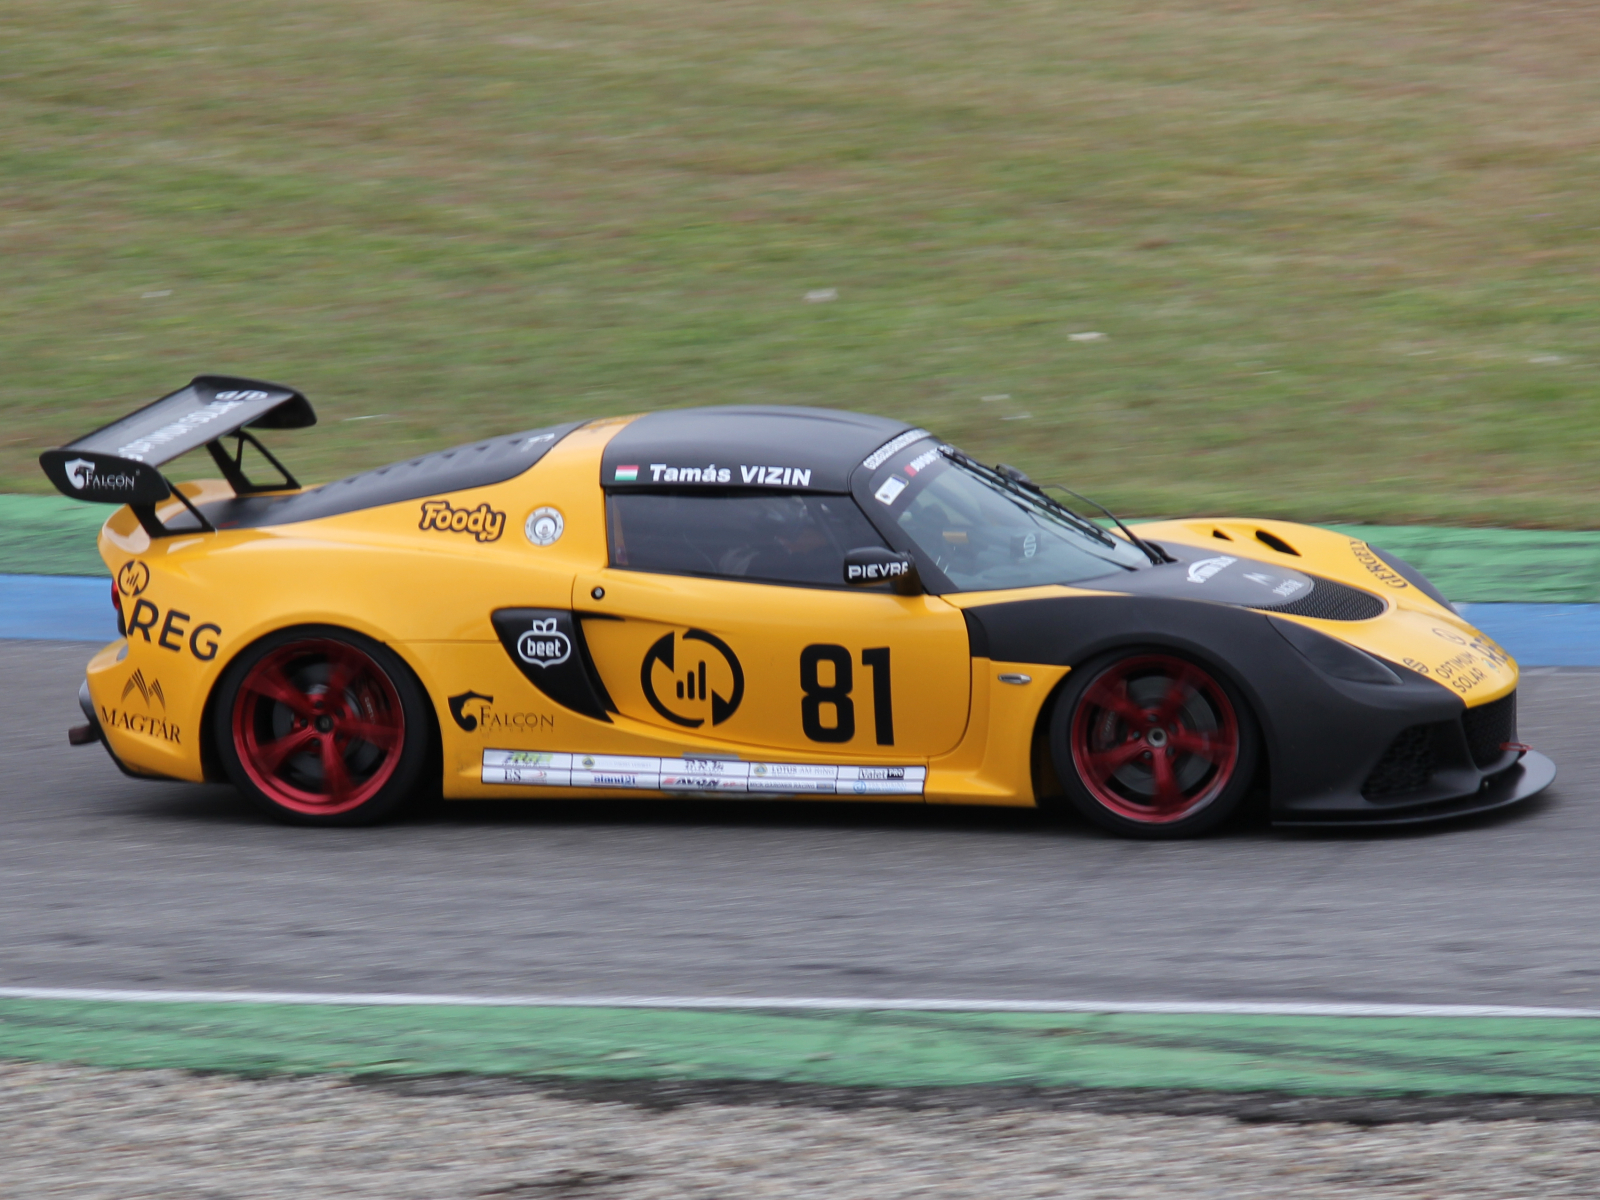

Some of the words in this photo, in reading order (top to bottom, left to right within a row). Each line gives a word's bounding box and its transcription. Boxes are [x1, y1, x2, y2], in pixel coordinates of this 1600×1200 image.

[650, 463, 731, 483] Tamás
[740, 465, 811, 486] VIZIN
[418, 500, 506, 542] Foody
[127, 597, 222, 662] REG
[527, 638, 562, 658] beet
[1435, 649, 1479, 680] OPTIMUM
[1452, 666, 1489, 693] SOLAR
[799, 642, 895, 747] 81
[480, 704, 554, 728] FALCON
[771, 765, 798, 774] LOTUS
